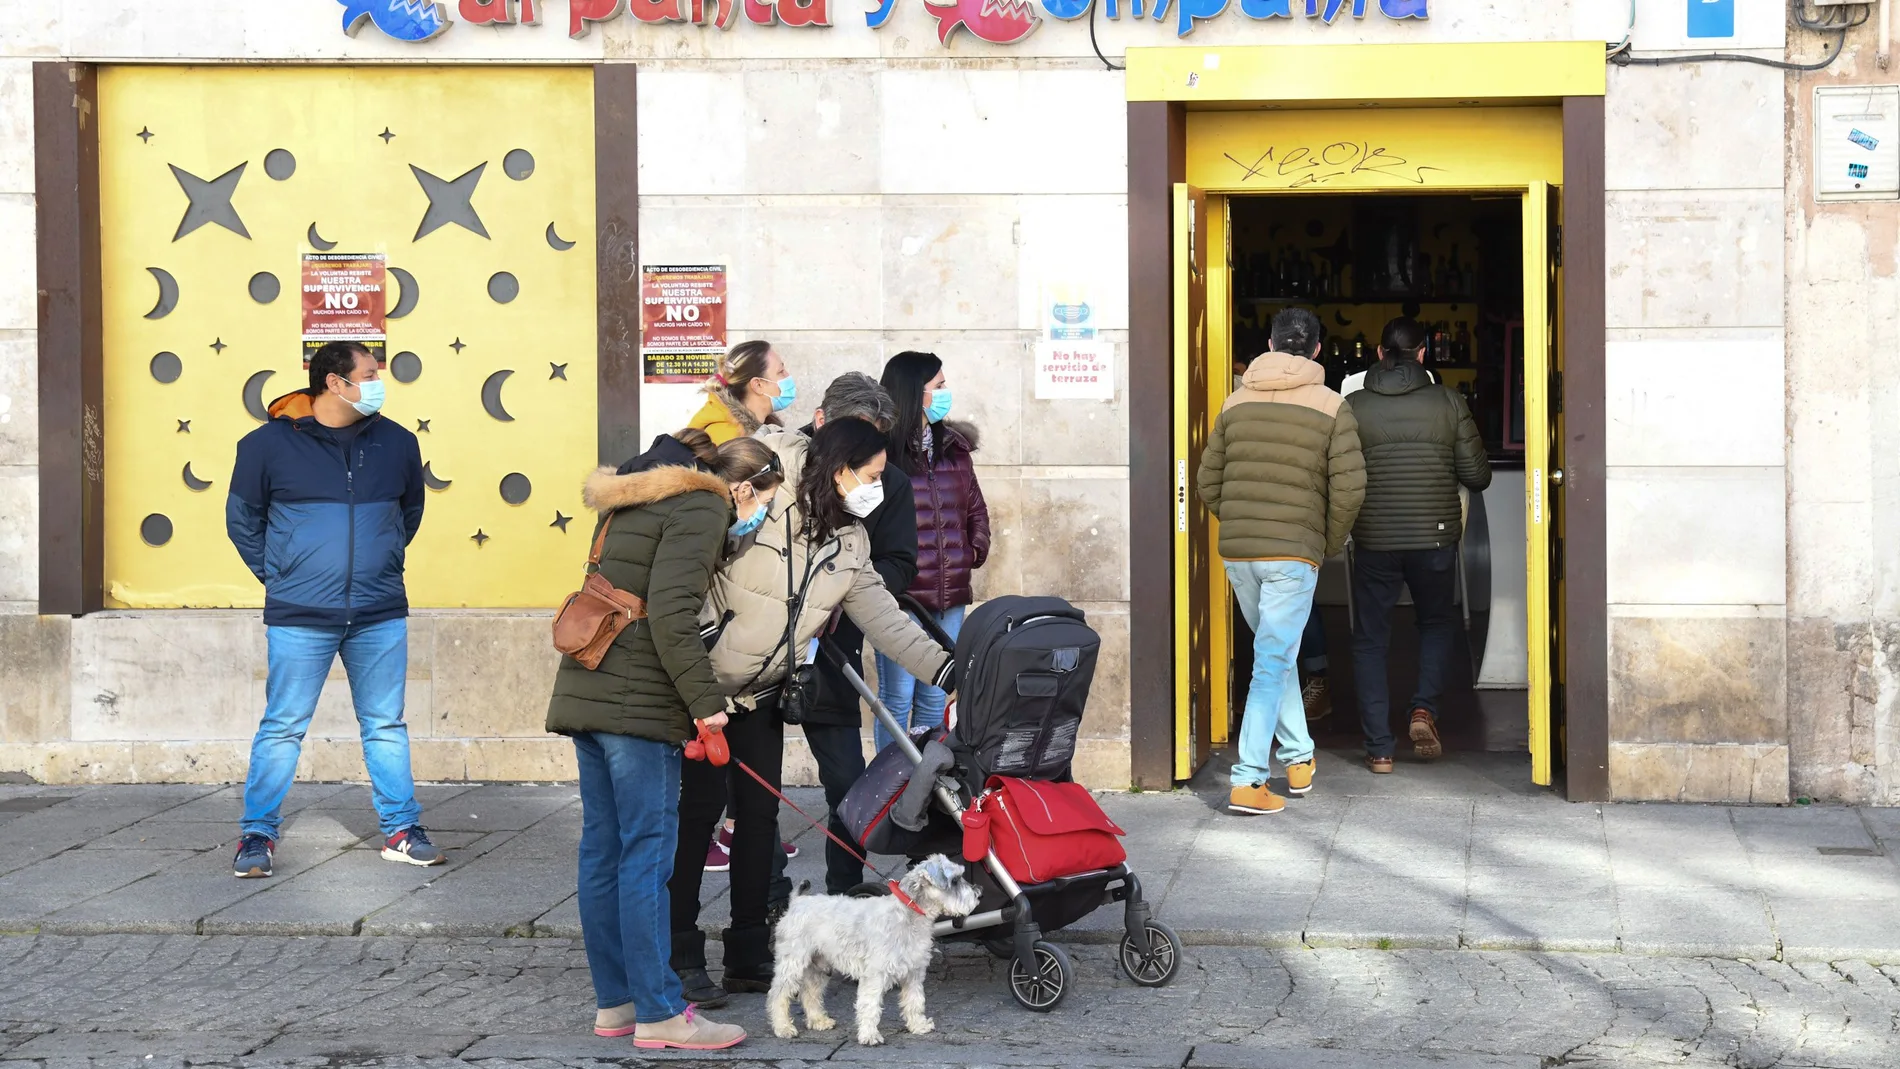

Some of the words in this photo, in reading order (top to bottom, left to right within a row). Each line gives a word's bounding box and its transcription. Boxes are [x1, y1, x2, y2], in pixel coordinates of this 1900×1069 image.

[325, 293, 358, 309] NO
[666, 305, 699, 321] NO
[1053, 351, 1070, 360] No
[1074, 351, 1096, 362] hay
[1043, 362, 1088, 372] servicio
[1092, 362, 1106, 371] de
[1052, 374, 1097, 383] terraza
